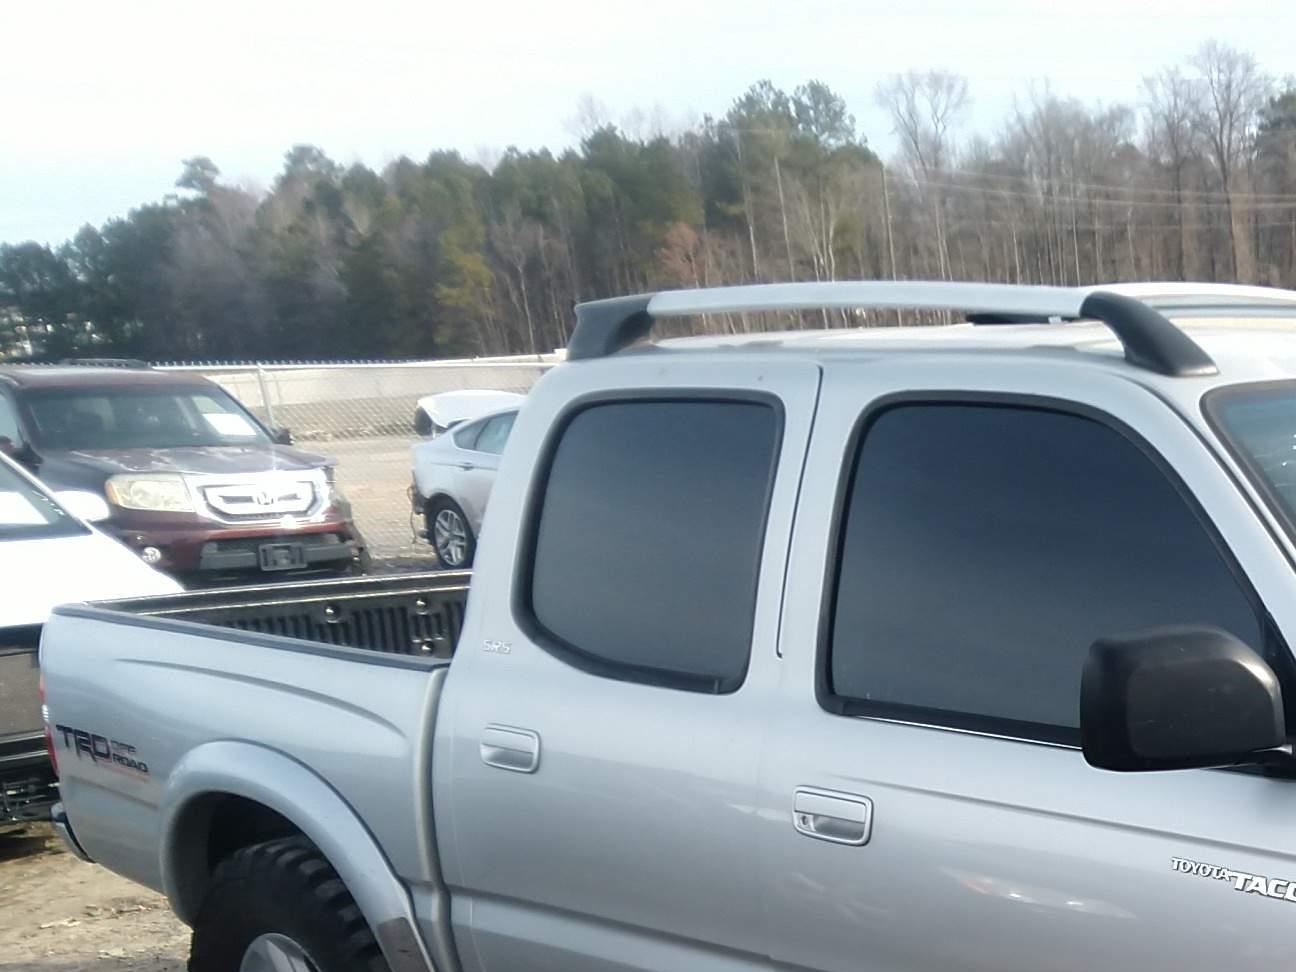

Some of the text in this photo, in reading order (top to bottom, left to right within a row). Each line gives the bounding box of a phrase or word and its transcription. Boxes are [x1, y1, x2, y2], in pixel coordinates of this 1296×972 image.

[55, 724, 110, 763] TRD
[112, 753, 149, 773] ROAD
[1170, 856, 1231, 882] TOYOTA
